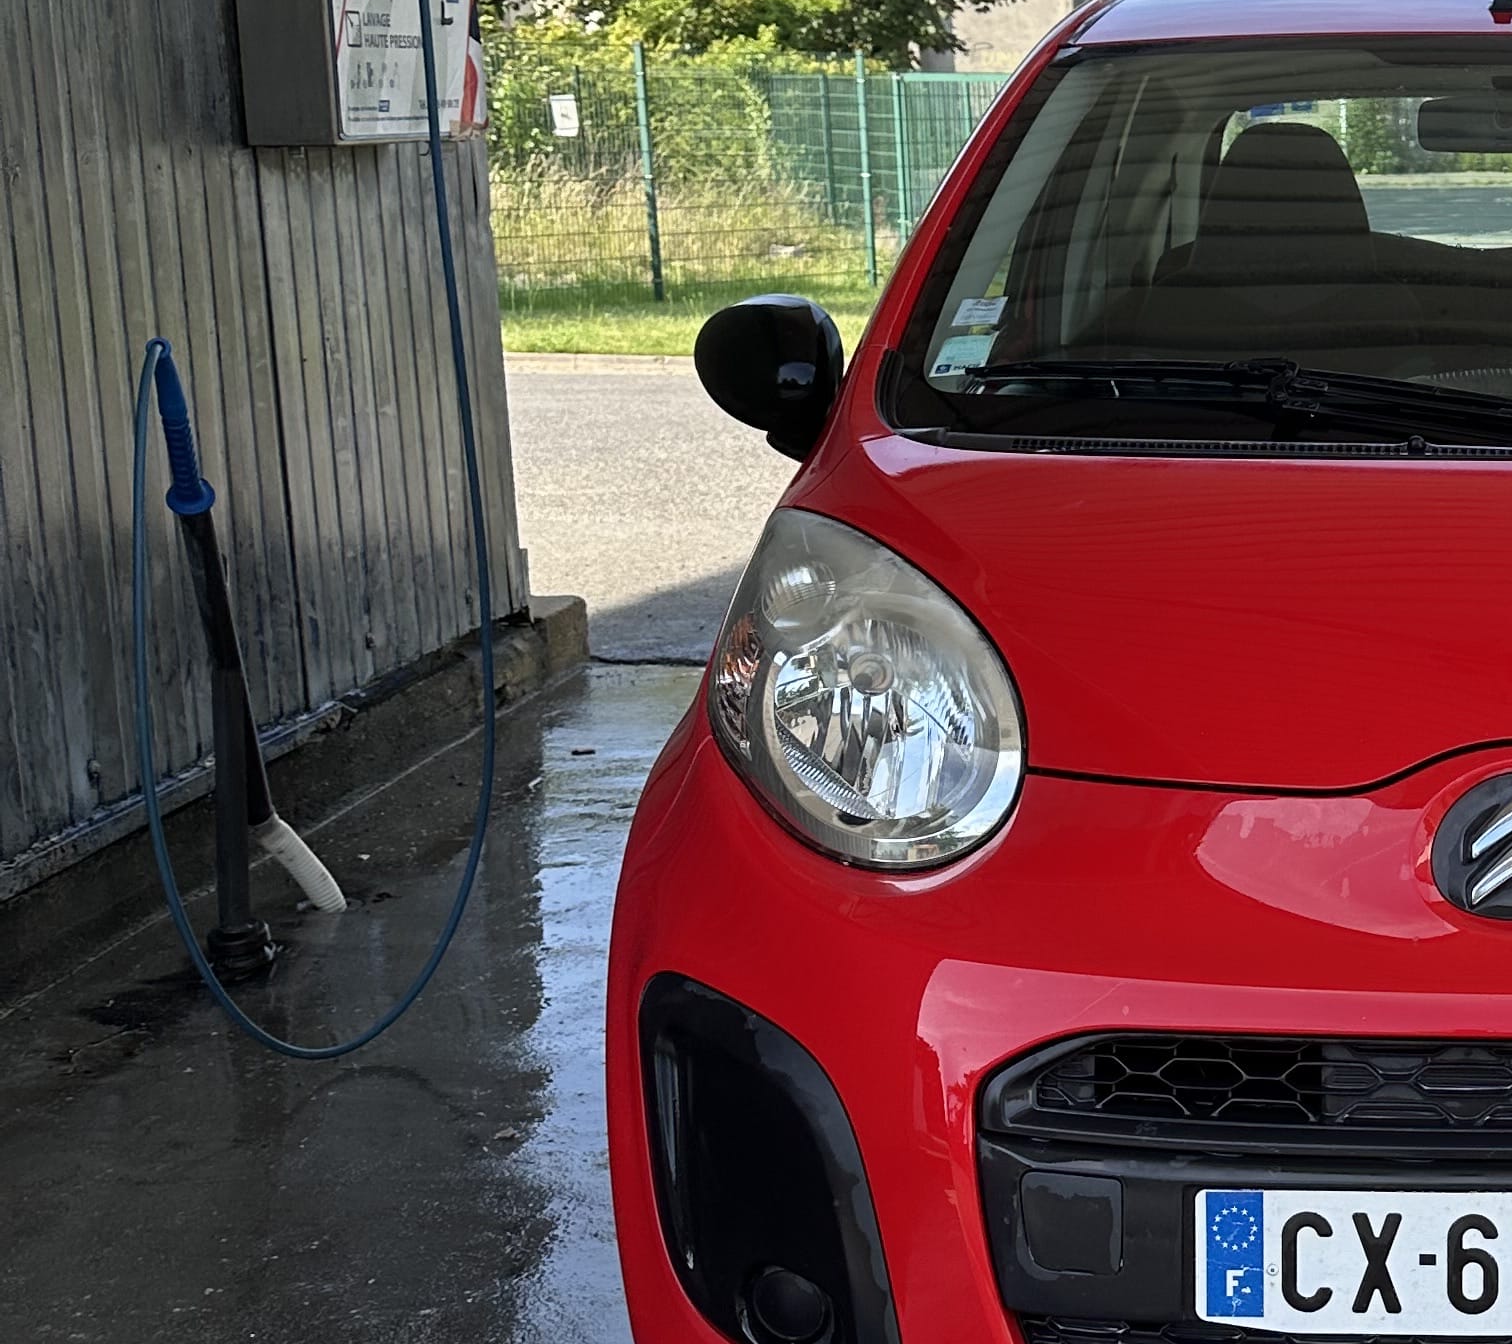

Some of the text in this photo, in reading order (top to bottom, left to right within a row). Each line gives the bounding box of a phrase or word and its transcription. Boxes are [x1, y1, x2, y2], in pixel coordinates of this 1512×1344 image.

[362, 12, 391, 27] LAVAGE
[364, 34, 389, 49] HAUTE
[1226, 1269, 1245, 1297] F
